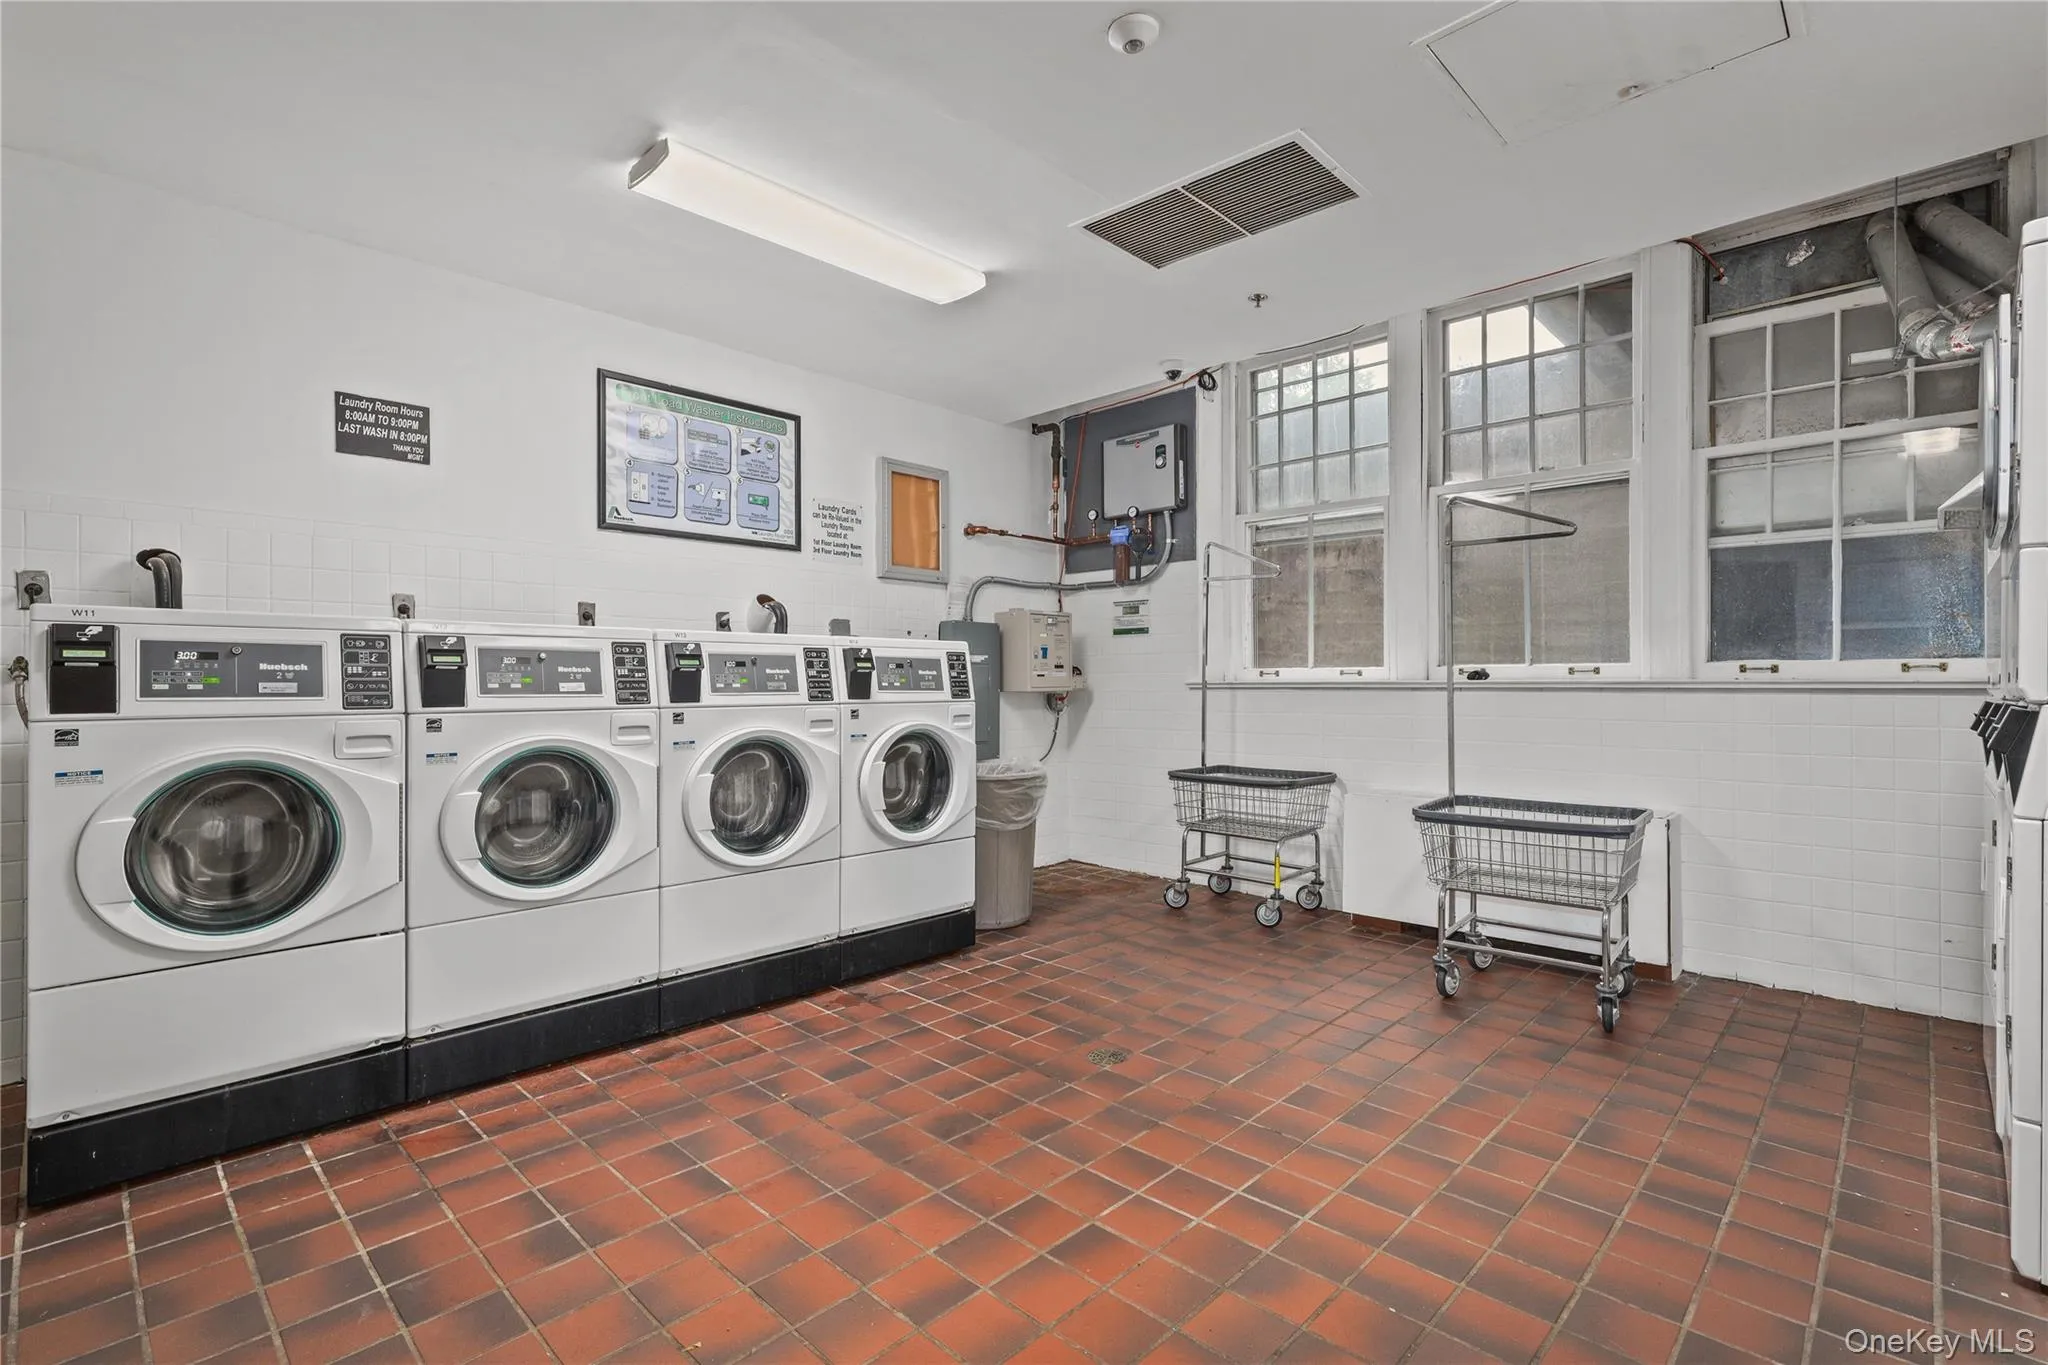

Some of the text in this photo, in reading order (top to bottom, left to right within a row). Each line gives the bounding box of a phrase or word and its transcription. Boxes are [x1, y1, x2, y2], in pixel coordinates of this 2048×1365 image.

[339, 395, 424, 418] Laundry Room Hours
[345, 410, 419, 430] 8:00AM TO 9:00PM
[686, 399, 727, 419] Washer
[727, 411, 784, 432] Instructions
[337, 422, 428, 444] LAST WASH IN 8:00PM
[392, 443, 424, 454] THANK YOU
[818, 503, 857, 516] Laundry Cards
[821, 521, 854, 532] Laundry Rooms
[826, 530, 842, 539] located
[833, 541, 850, 550] Laundry
[833, 549, 850, 558] Laundry
[72, 609, 95, 617] W11
[259, 662, 308, 671] Huebsch
[557, 666, 592, 674] Huebsch
